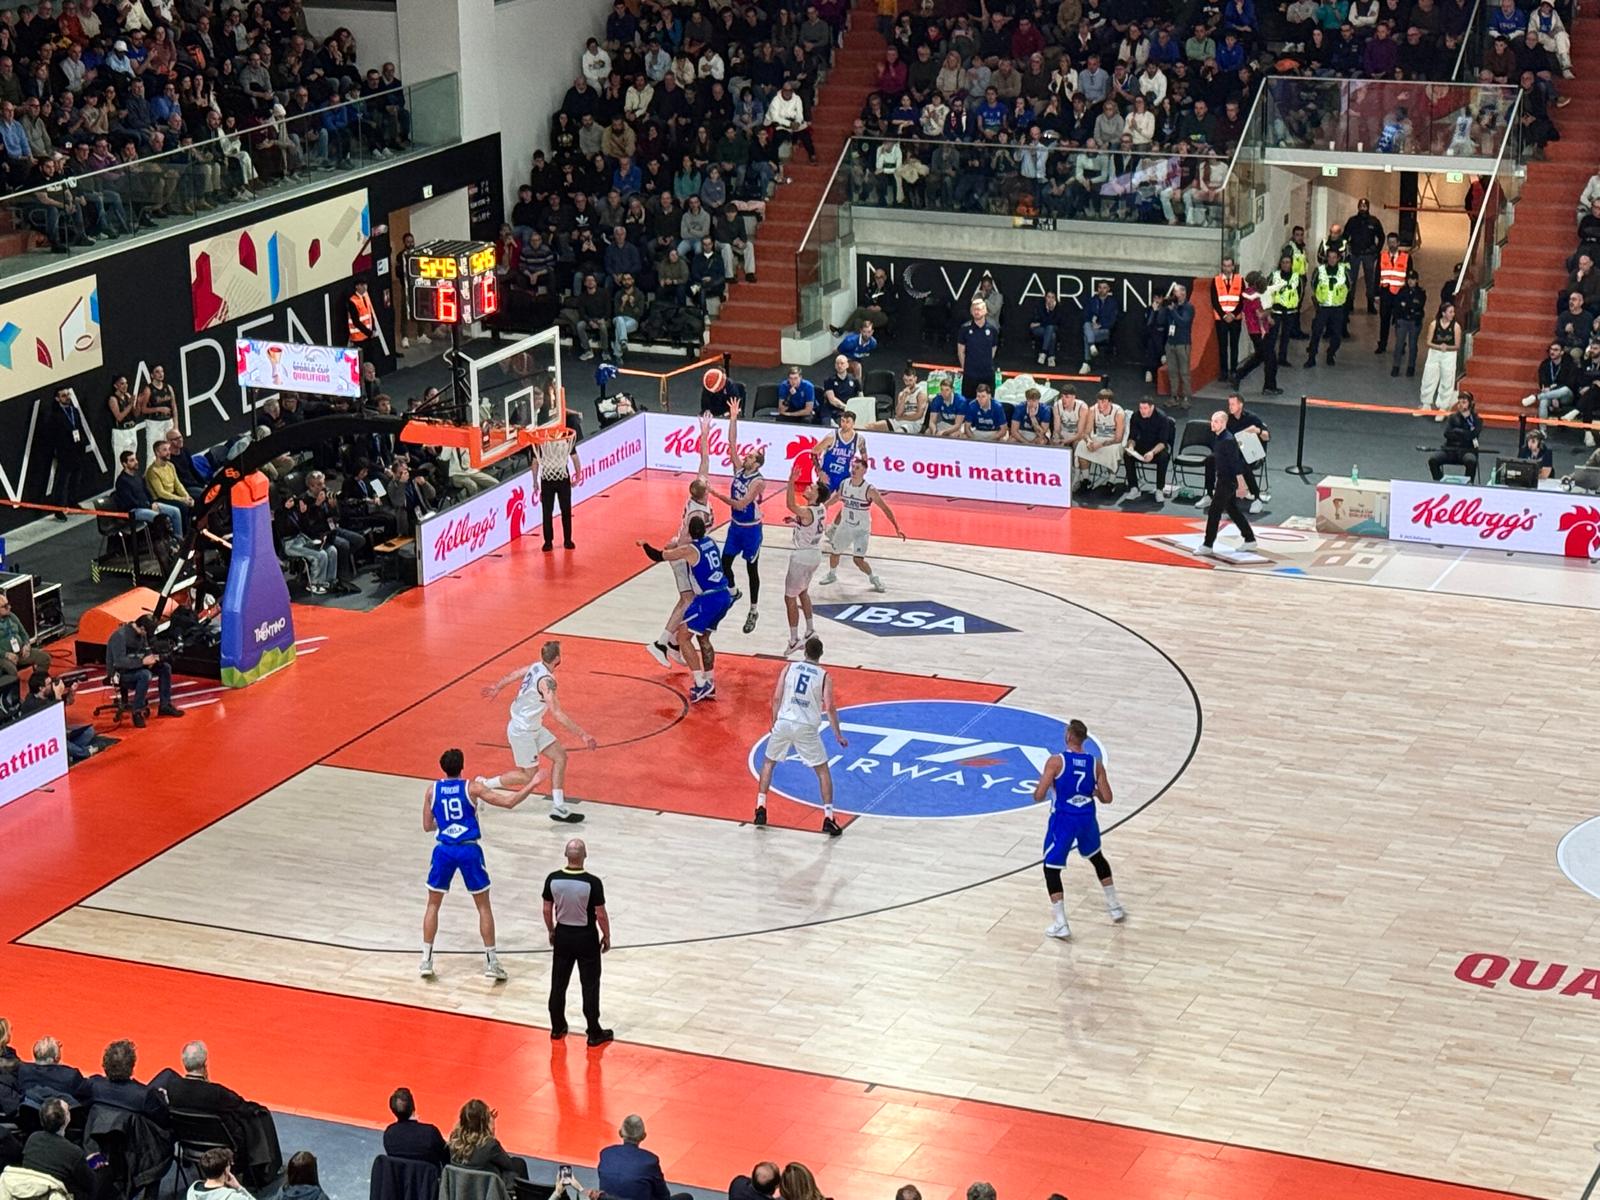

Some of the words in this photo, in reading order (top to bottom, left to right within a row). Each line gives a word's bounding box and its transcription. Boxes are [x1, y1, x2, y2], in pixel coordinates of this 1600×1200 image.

[419, 256, 457, 279] 5:45
[438, 286, 457, 322] 6
[482, 277, 496, 313] 6
[883, 456, 905, 472] te
[912, 461, 962, 479] ogni
[968, 465, 1062, 487] mattina
[434, 508, 498, 562] Kellogg's
[599, 439, 642, 473] mattina
[1411, 493, 1538, 541] Kellogg's
[705, 550, 720, 570] 16
[834, 605, 966, 633] IBSA
[796, 673, 810, 695] 6
[1073, 771, 1086, 792] 7
[441, 797, 463, 821] 19
[1454, 952, 1600, 1000] QUA
